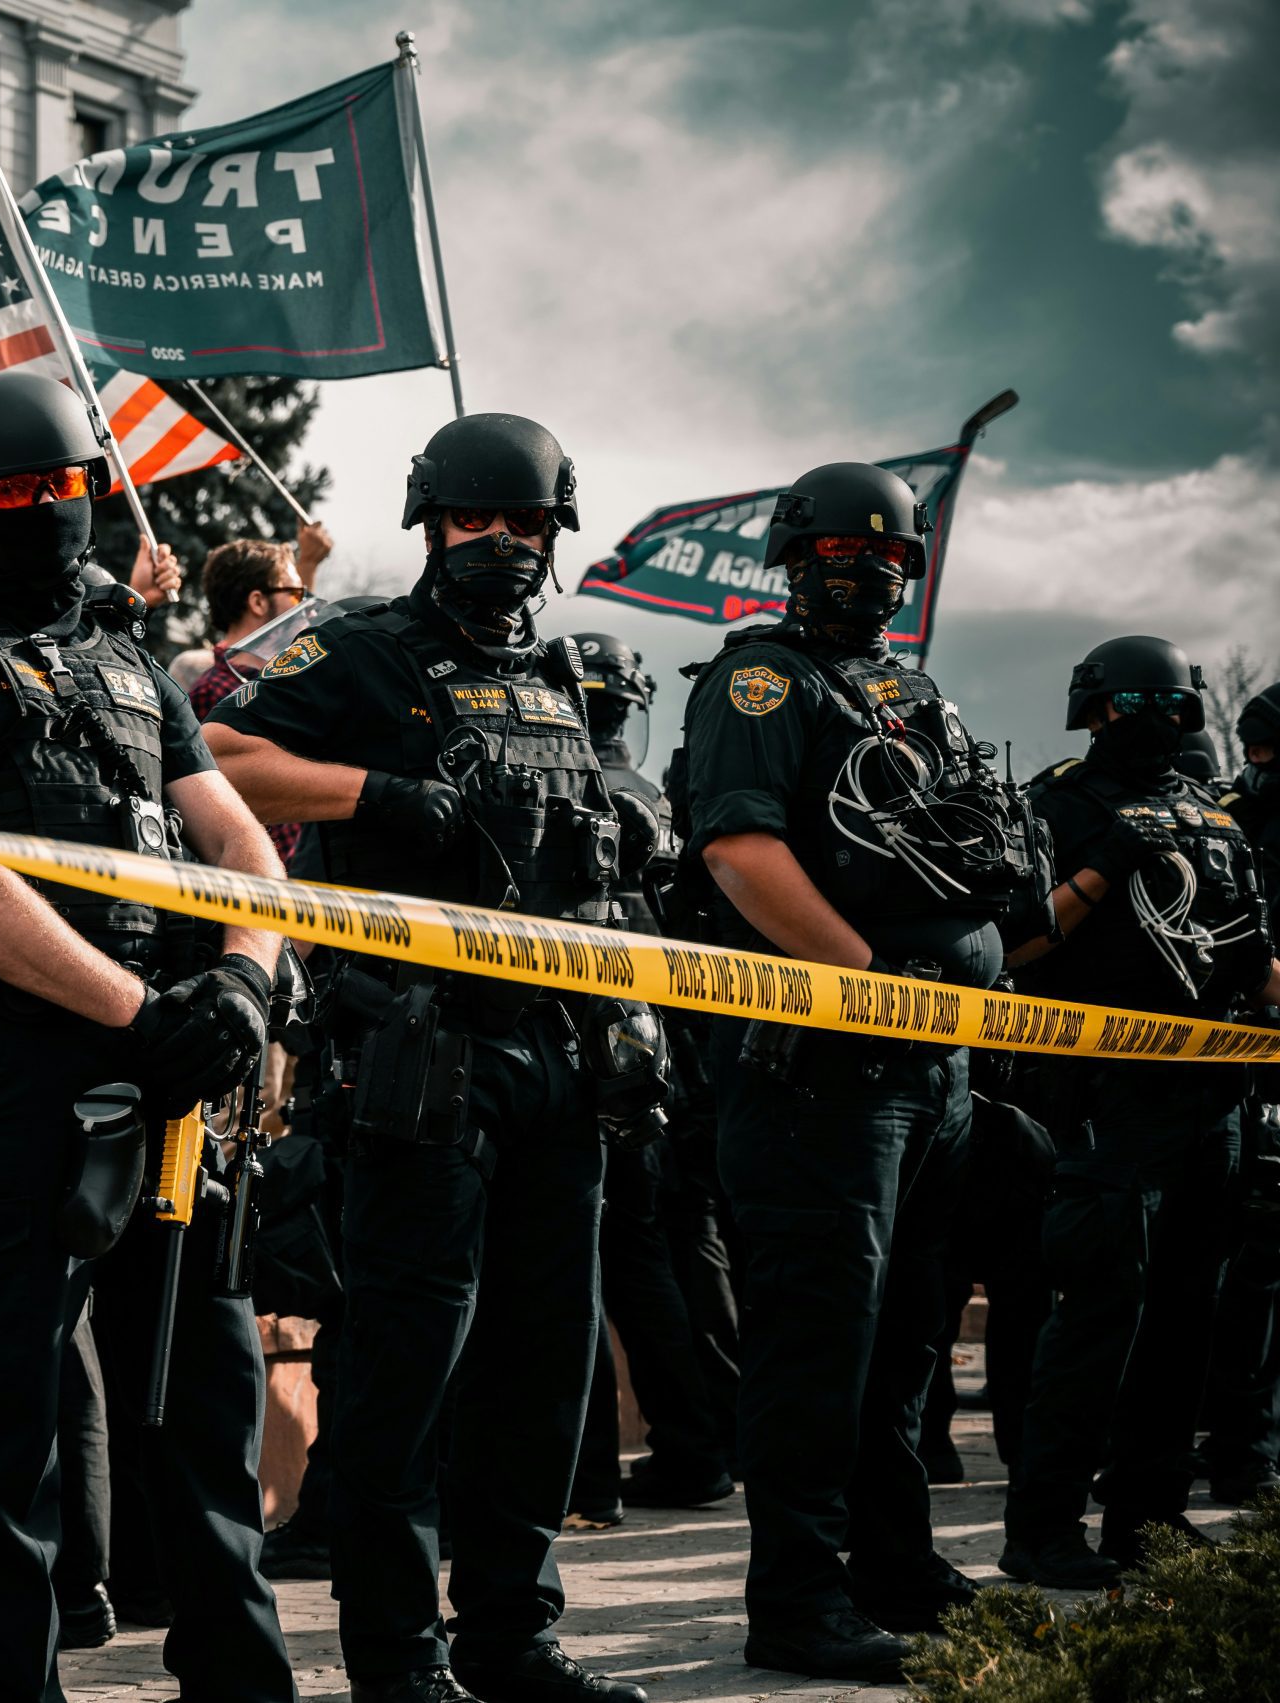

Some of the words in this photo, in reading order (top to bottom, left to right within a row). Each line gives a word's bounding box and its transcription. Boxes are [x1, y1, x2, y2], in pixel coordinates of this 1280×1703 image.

[736, 670, 784, 688] COLORADO
[866, 679, 899, 693] BARRY
[453, 688, 507, 700] WILLIAMS
[733, 690, 750, 708] STATE
[751, 697, 780, 710] PATROL
[470, 699, 500, 710] 9444
[440, 907, 502, 965] POLICE
[494, 917, 538, 971] LINE
[531, 923, 560, 976] DO
[554, 927, 589, 980] NOT
[585, 932, 634, 988] CROSS
[661, 946, 706, 1000] POLICE
[704, 953, 735, 1004] LINE
[734, 958, 753, 1008] DO
[752, 961, 776, 1011] NOT
[778, 965, 813, 1017] CROSS
[839, 975, 871, 1025] POLICE
[873, 981, 895, 1028] LINE
[896, 984, 911, 1030] DO
[910, 987, 930, 1032] NOT
[930, 990, 960, 1036] CROSS
[978, 998, 1011, 1041] POLICE
[1006, 1002, 1030, 1043] LINE
[1024, 1005, 1043, 1045] DO
[1037, 1006, 1061, 1047] NOT
[1053, 1008, 1085, 1049] CROSS
